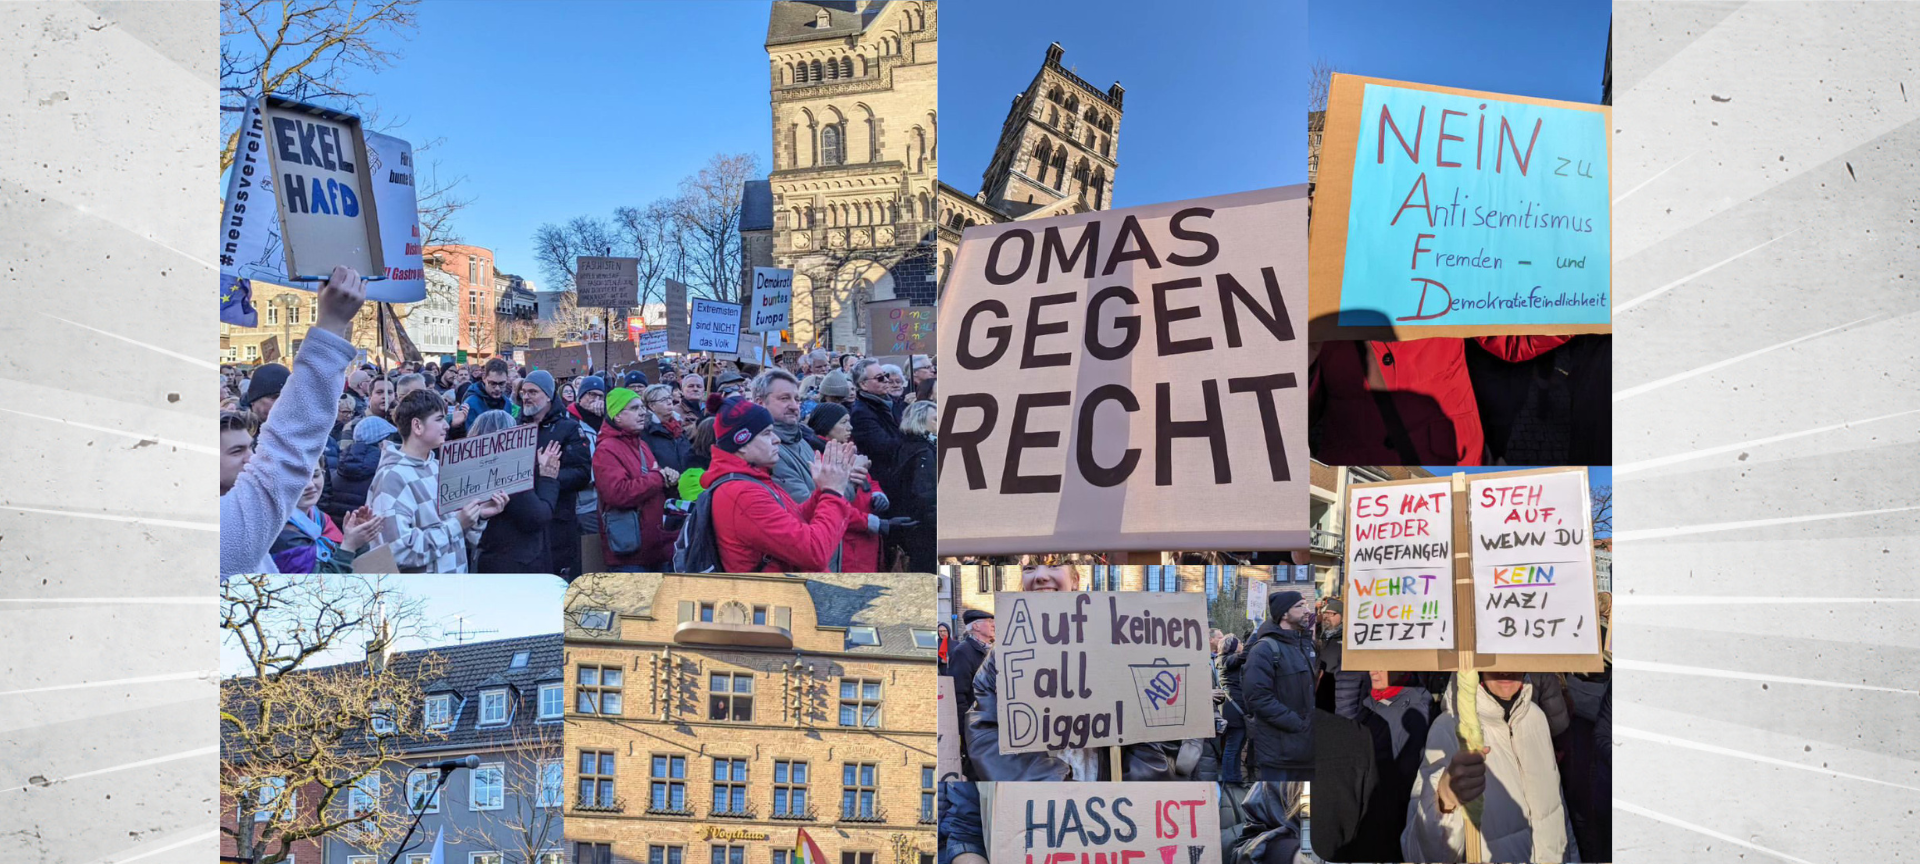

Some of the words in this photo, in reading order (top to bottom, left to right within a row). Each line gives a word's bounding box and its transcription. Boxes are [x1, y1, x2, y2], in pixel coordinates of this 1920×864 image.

[272, 116, 354, 174] EKEL
[1389, 171, 1593, 233] Antisemitismus
[984, 207, 1219, 286] OMAS
[1555, 255, 1586, 269] und
[697, 303, 738, 316] Extremisten
[762, 291, 788, 307] buntes
[1395, 277, 1608, 322] Demokratiefeindlichkeit
[696, 321, 711, 330] sind
[713, 322, 736, 334] NICHT
[755, 311, 784, 326] Europa
[955, 266, 1295, 370] GEGEN
[700, 337, 713, 347] das
[714, 339, 730, 349] Volk
[937, 372, 1298, 494] RECHT
[441, 426, 537, 467] MENSCHENRECHTE
[440, 475, 480, 504] Rechten
[486, 460, 534, 490] Menschen
[1356, 494, 1389, 518] ES
[1399, 492, 1447, 516] HAT
[1480, 484, 1543, 508] STEH
[1356, 518, 1430, 542] WIEDER
[1480, 530, 1546, 551] WENN
[1553, 528, 1584, 546] DU
[1353, 540, 1449, 565] ANGEFANGEN
[1354, 574, 1437, 597] WEHRT
[1494, 565, 1554, 585] KEIN
[1357, 600, 1414, 620] EUCH
[1486, 591, 1548, 610] NAZI
[1002, 593, 1091, 646] Auf
[1108, 595, 1203, 651] keinen
[1003, 648, 1093, 701] Fall
[1144, 670, 1178, 711] AfD
[1006, 700, 1124, 751] Digga!
[1025, 796, 1138, 848] HASS
[1155, 799, 1206, 839] IST
